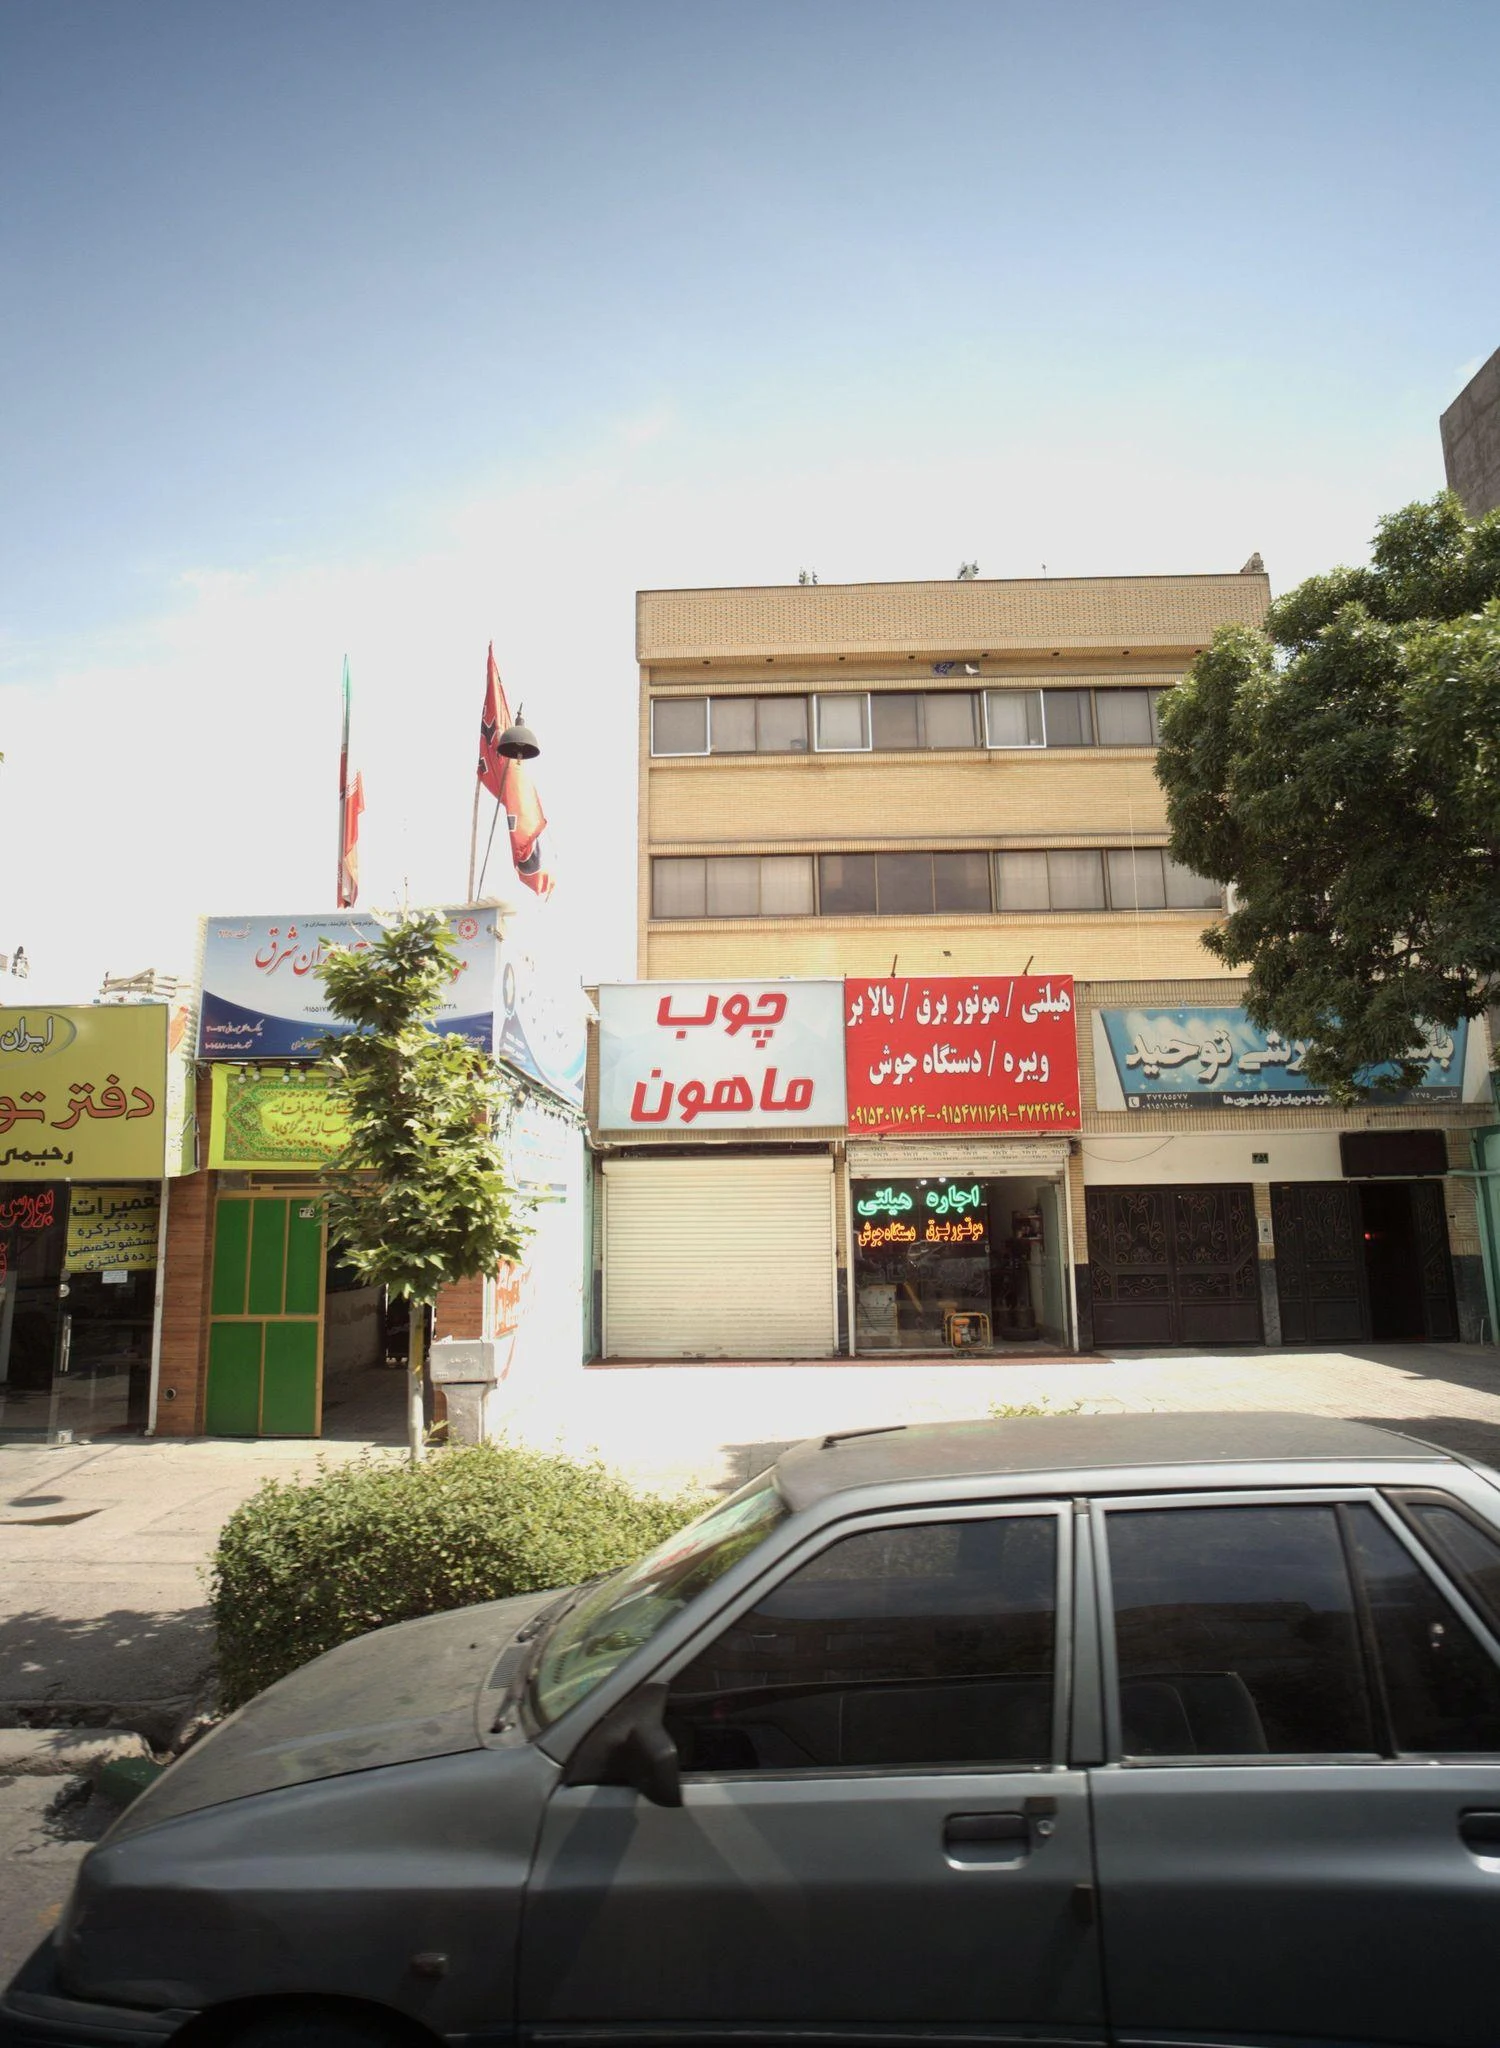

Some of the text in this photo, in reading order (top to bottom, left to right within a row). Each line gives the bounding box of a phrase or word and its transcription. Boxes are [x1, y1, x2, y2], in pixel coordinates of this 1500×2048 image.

[255, 923, 299, 975] شرق
[656, 992, 787, 1048] چوب
[847, 994, 864, 1026] بر
[867, 984, 894, 1023] بالا
[916, 989, 948, 1025] برق
[953, 985, 1000, 1025] موتور
[1021, 982, 1071, 1024] هیلتی
[869, 1045, 917, 1085] جوش
[923, 1043, 982, 1074] دستگاه
[1003, 1050, 1049, 1083] ویبره
[1126, 1030, 1232, 1083] توحید
[50, 1074, 155, 1129] دفتر
[630, 1067, 814, 1123] ماهون
[0, 1146, 73, 1166] رحیمی
[858, 1185, 980, 1216] اجاره هیلتی
[77, 1221, 122, 1239] کرکره
[858, 1216, 984, 1247] موتور برق دستگاه جوش
[84, 1252, 129, 1270] فانتزی
